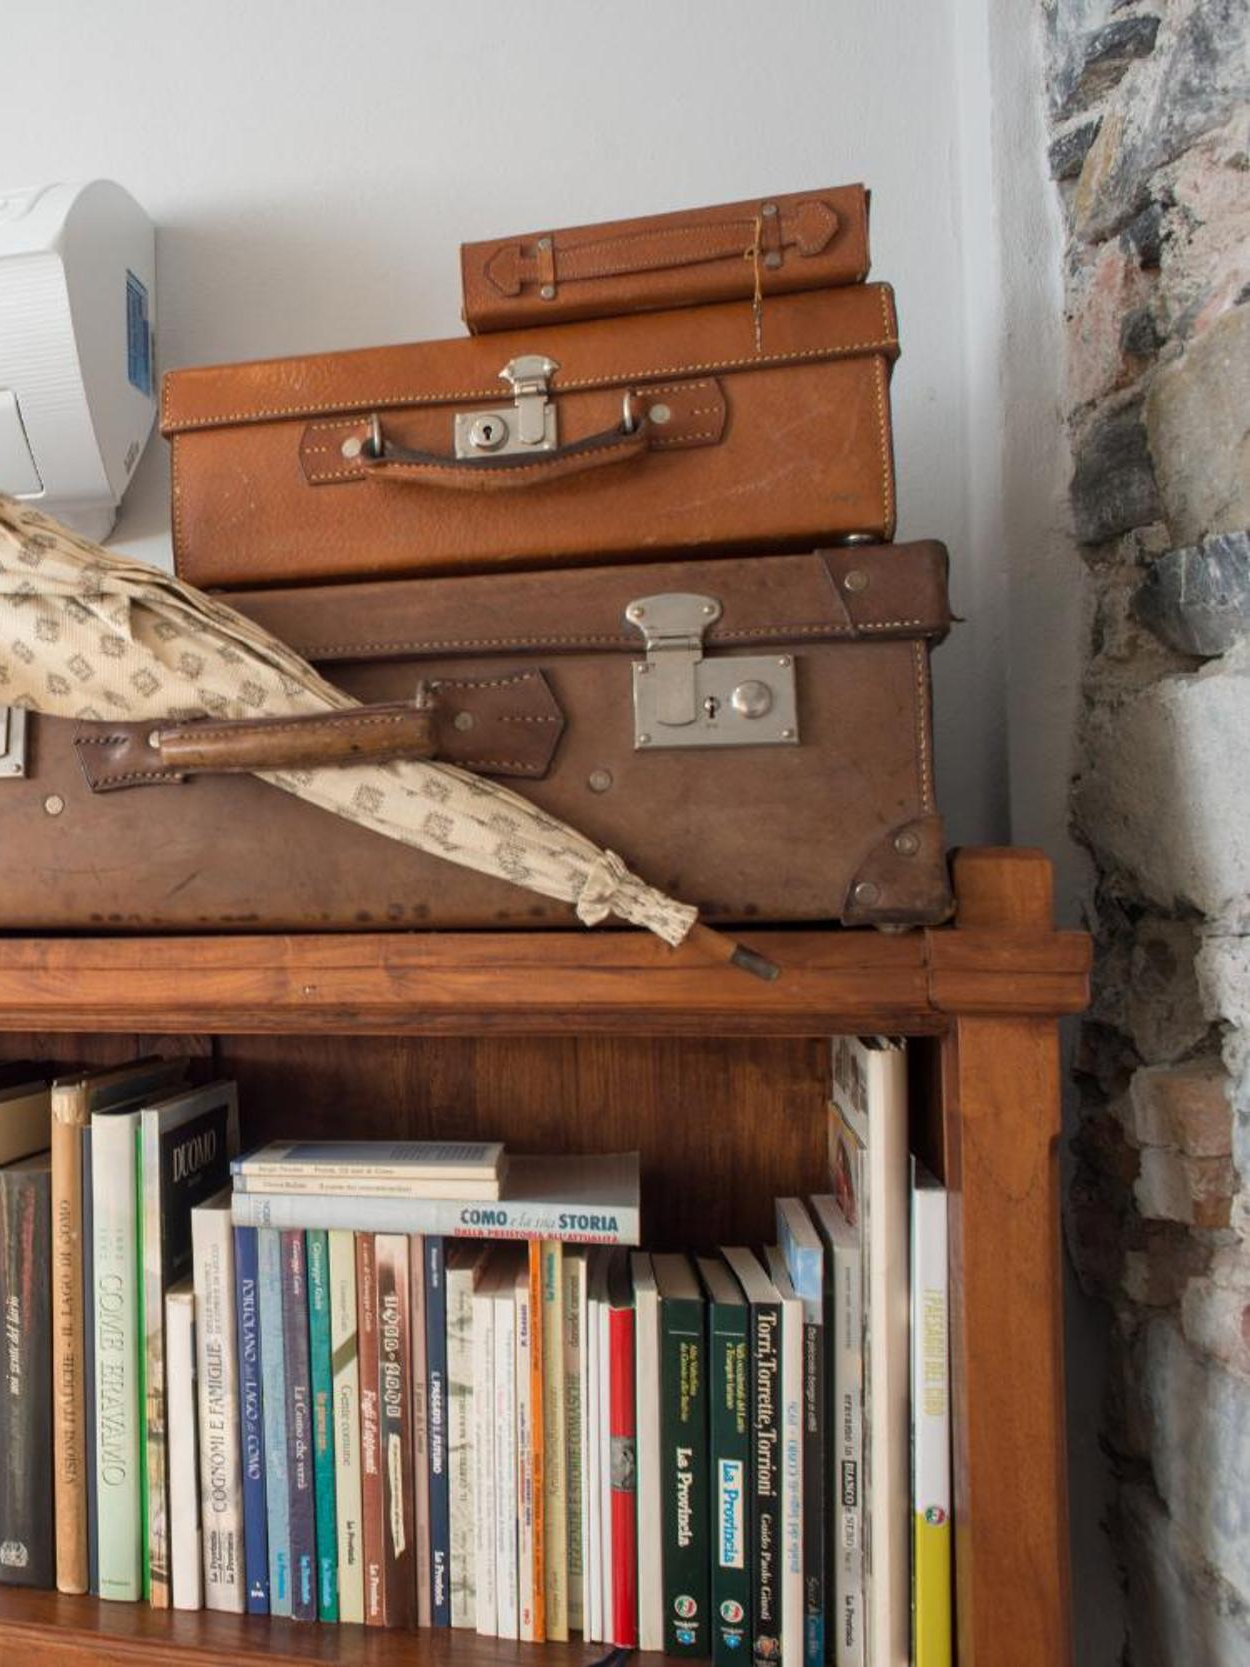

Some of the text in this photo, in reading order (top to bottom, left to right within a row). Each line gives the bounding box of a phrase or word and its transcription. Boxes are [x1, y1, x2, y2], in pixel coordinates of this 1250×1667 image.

[172, 1130, 216, 1183] DUOMO
[454, 1227, 545, 1240] DALLA PREISTORIA
[459, 1208, 508, 1226] COMO
[558, 1213, 619, 1232] STORIA
[312, 1242, 324, 1286] Giuseppe
[99, 1273, 125, 1352] COME
[59, 1200, 77, 1485] VISIONI ITALICHE IL LAGO DI COMO
[245, 1381, 257, 1421] LAGO
[294, 1386, 305, 1401] La
[431, 1380, 442, 1424] PASSATO
[99, 1358, 127, 1487] ERAVAMO
[205, 1343, 228, 1513] COGNOMI E FAMIGLIE
[295, 1402, 306, 1437] Como
[247, 1434, 260, 1479] COMO
[296, 1438, 306, 1460] che
[342, 1421, 353, 1467] comune
[432, 1434, 443, 1475] FUTURO
[677, 1447, 693, 1548] La Provincia
[844, 1462, 855, 1505] BIANCO
[723, 1463, 739, 1563] La Provincia
[760, 1513, 772, 1549] Guido
[369, 1564, 379, 1575] La
[434, 1551, 444, 1606] La Provincia
[760, 1551, 772, 1584] Paolo
[846, 1595, 855, 1647] La Provincia
